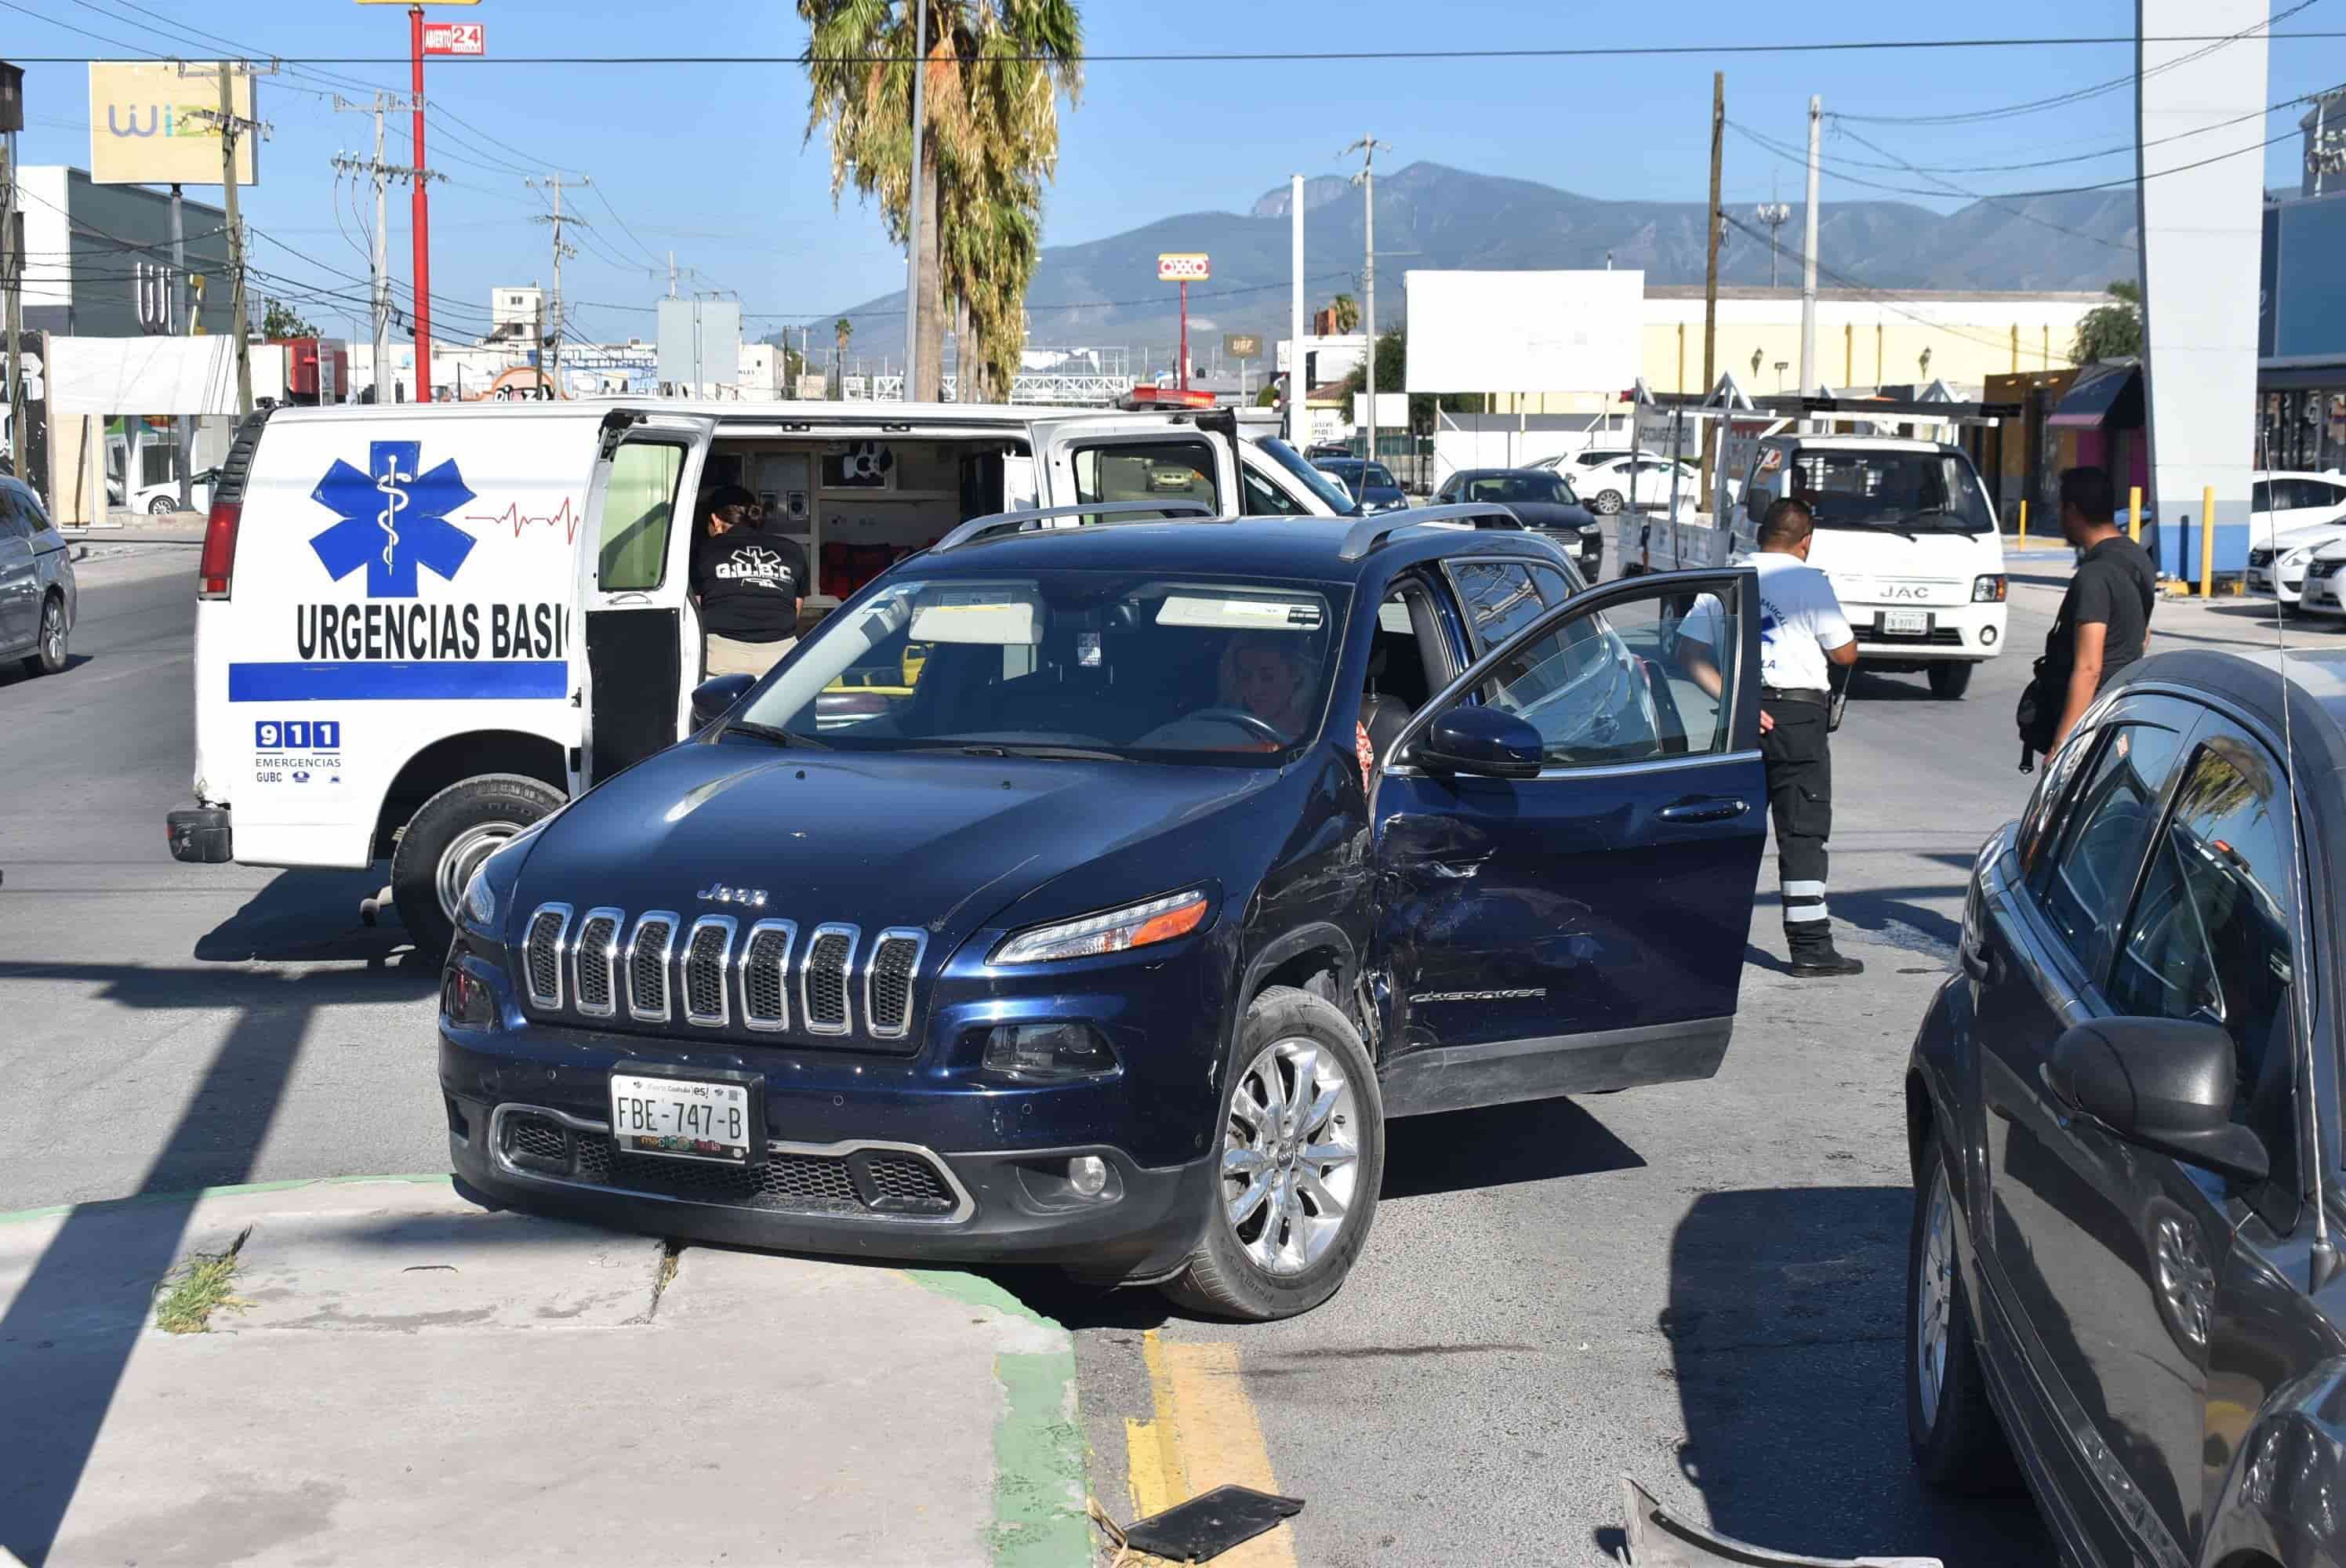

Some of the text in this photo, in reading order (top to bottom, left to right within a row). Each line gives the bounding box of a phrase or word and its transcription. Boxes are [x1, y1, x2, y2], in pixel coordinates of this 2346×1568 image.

[453, 27, 478, 43] 24
[1160, 260, 1207, 275] OXXO
[1879, 586, 1929, 598] JAC
[297, 603, 570, 660] URGENCIAS BASI
[260, 724, 332, 746] 911
[256, 758, 341, 768] EMERGENCIAS
[256, 771, 282, 782] GUBC
[697, 883, 768, 906] Jeep
[618, 1097, 741, 1139] FBE-747-B
